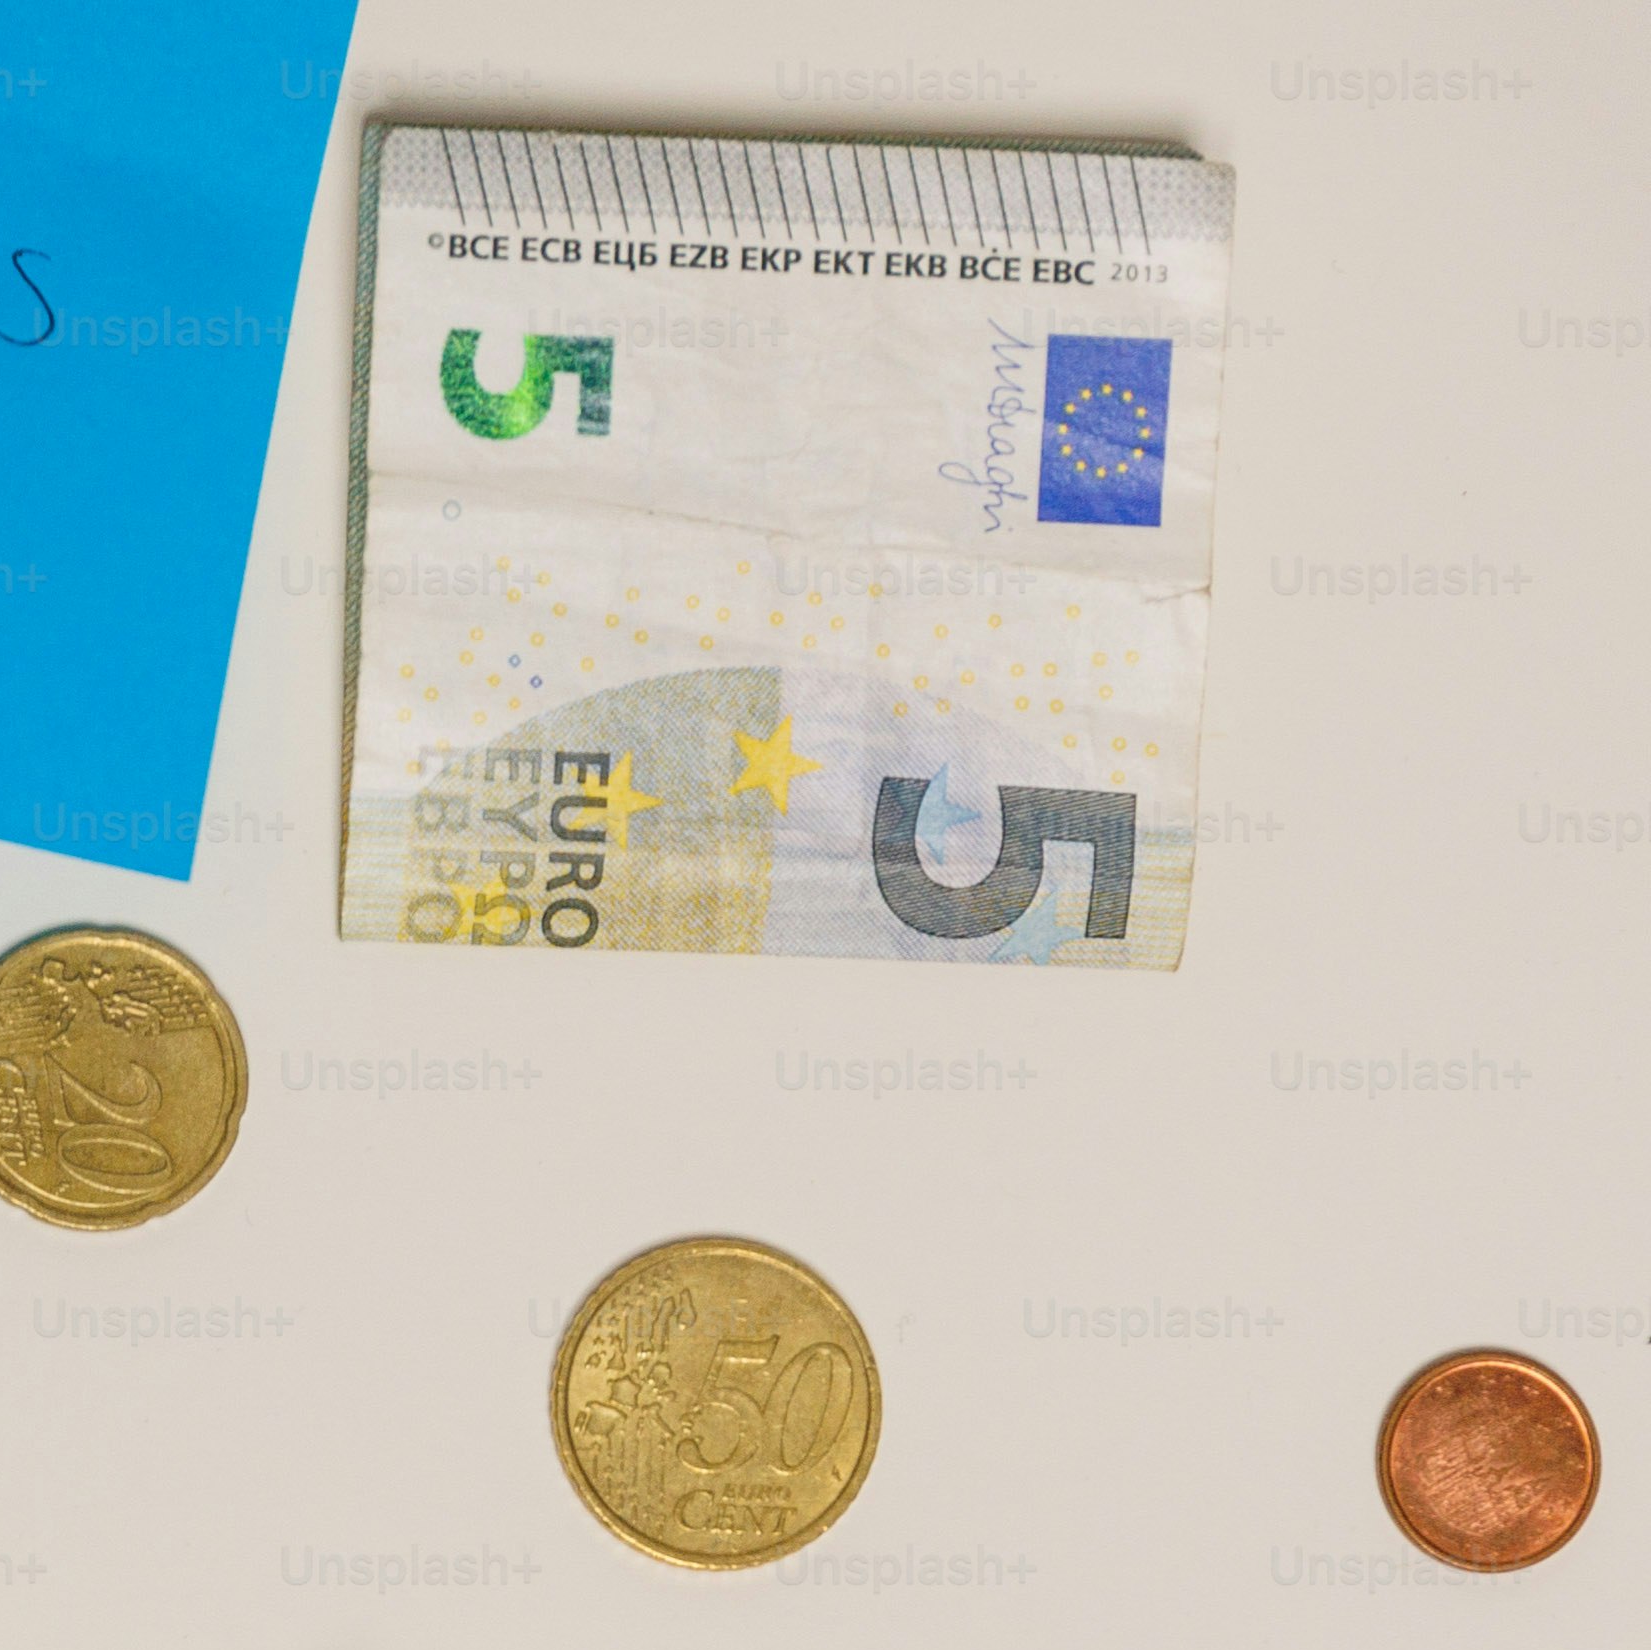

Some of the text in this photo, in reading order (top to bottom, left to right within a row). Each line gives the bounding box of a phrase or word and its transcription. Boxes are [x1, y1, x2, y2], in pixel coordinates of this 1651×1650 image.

[521, 235, 582, 264] ECB
[669, 241, 729, 271] EZB
[740, 245, 801, 274] EKP
[813, 248, 874, 275] EKT
[885, 251, 947, 279] EKB
[1032, 257, 1095, 286] EBC
[1110, 261, 1169, 284] 2013
[439, 327, 614, 441] 5
[541, 750, 611, 948] EURO
[871, 775, 1138, 940] 5
[44, 1053, 174, 1194] 20
[675, 1334, 854, 1476] 50
